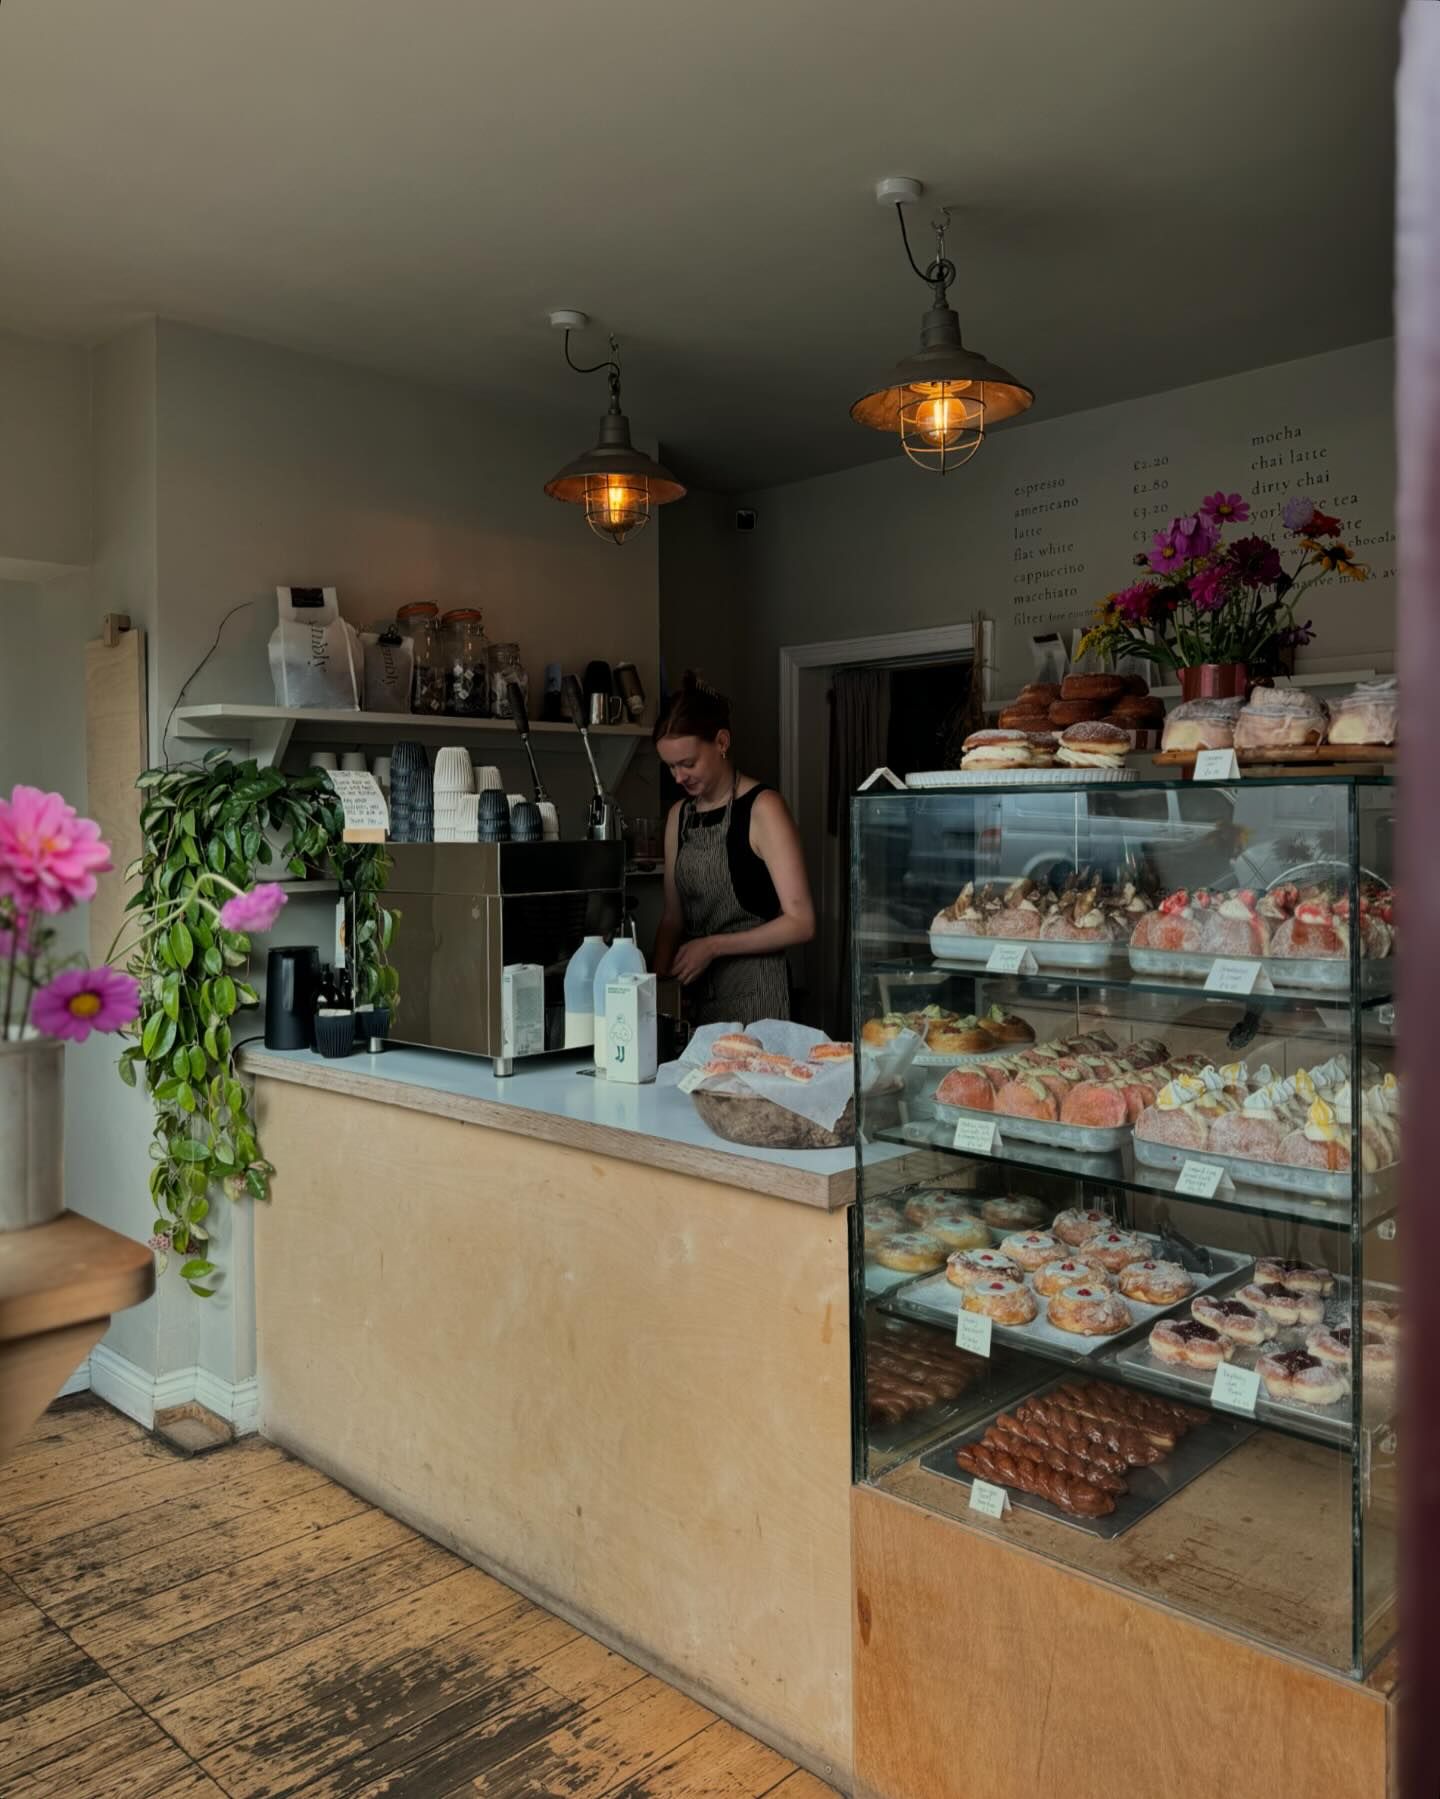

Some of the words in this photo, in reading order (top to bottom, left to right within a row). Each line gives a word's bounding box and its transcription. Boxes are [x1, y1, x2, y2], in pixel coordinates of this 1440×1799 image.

[1251, 425, 1302, 446] mocha
[1251, 454, 1283, 471] chai
[1290, 448, 1328, 464] latte
[1013, 477, 1065, 497] espresso
[1251, 478, 1290, 496] dirty
[1296, 470, 1330, 488] chai
[1013, 497, 1079, 518] americano
[1334, 493, 1359, 508] tea
[1013, 527, 1043, 541] latte
[1013, 547, 1034, 561] flat
[1038, 542, 1074, 557] white
[1013, 564, 1085, 584] cappuccino
[1013, 586, 1078, 605] macchiato
[1013, 612, 1043, 625] filter
